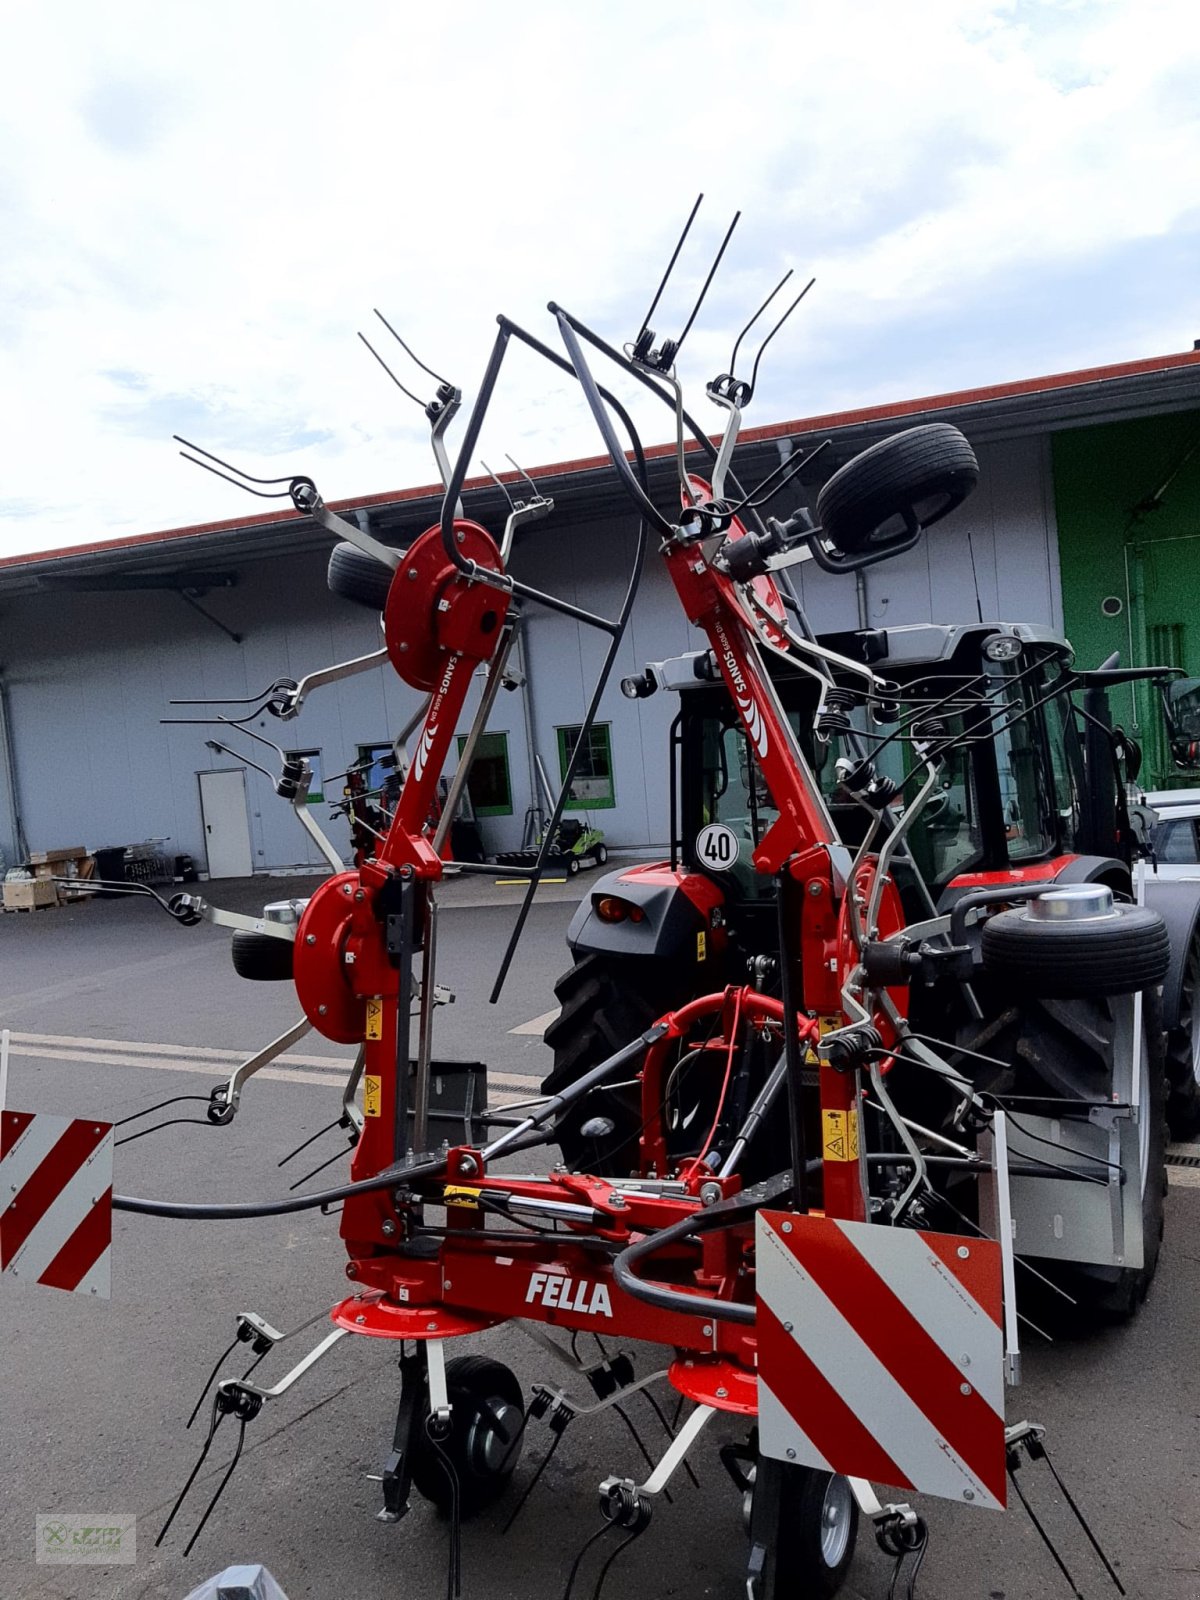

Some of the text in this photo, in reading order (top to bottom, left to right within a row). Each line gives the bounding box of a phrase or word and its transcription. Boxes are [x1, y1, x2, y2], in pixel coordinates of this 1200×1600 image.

[719, 632, 731, 651] 6606
[439, 656, 458, 695] SANOS
[723, 650, 747, 693] SANOS
[704, 832, 730, 862] 40
[525, 1272, 613, 1318] FELLA
